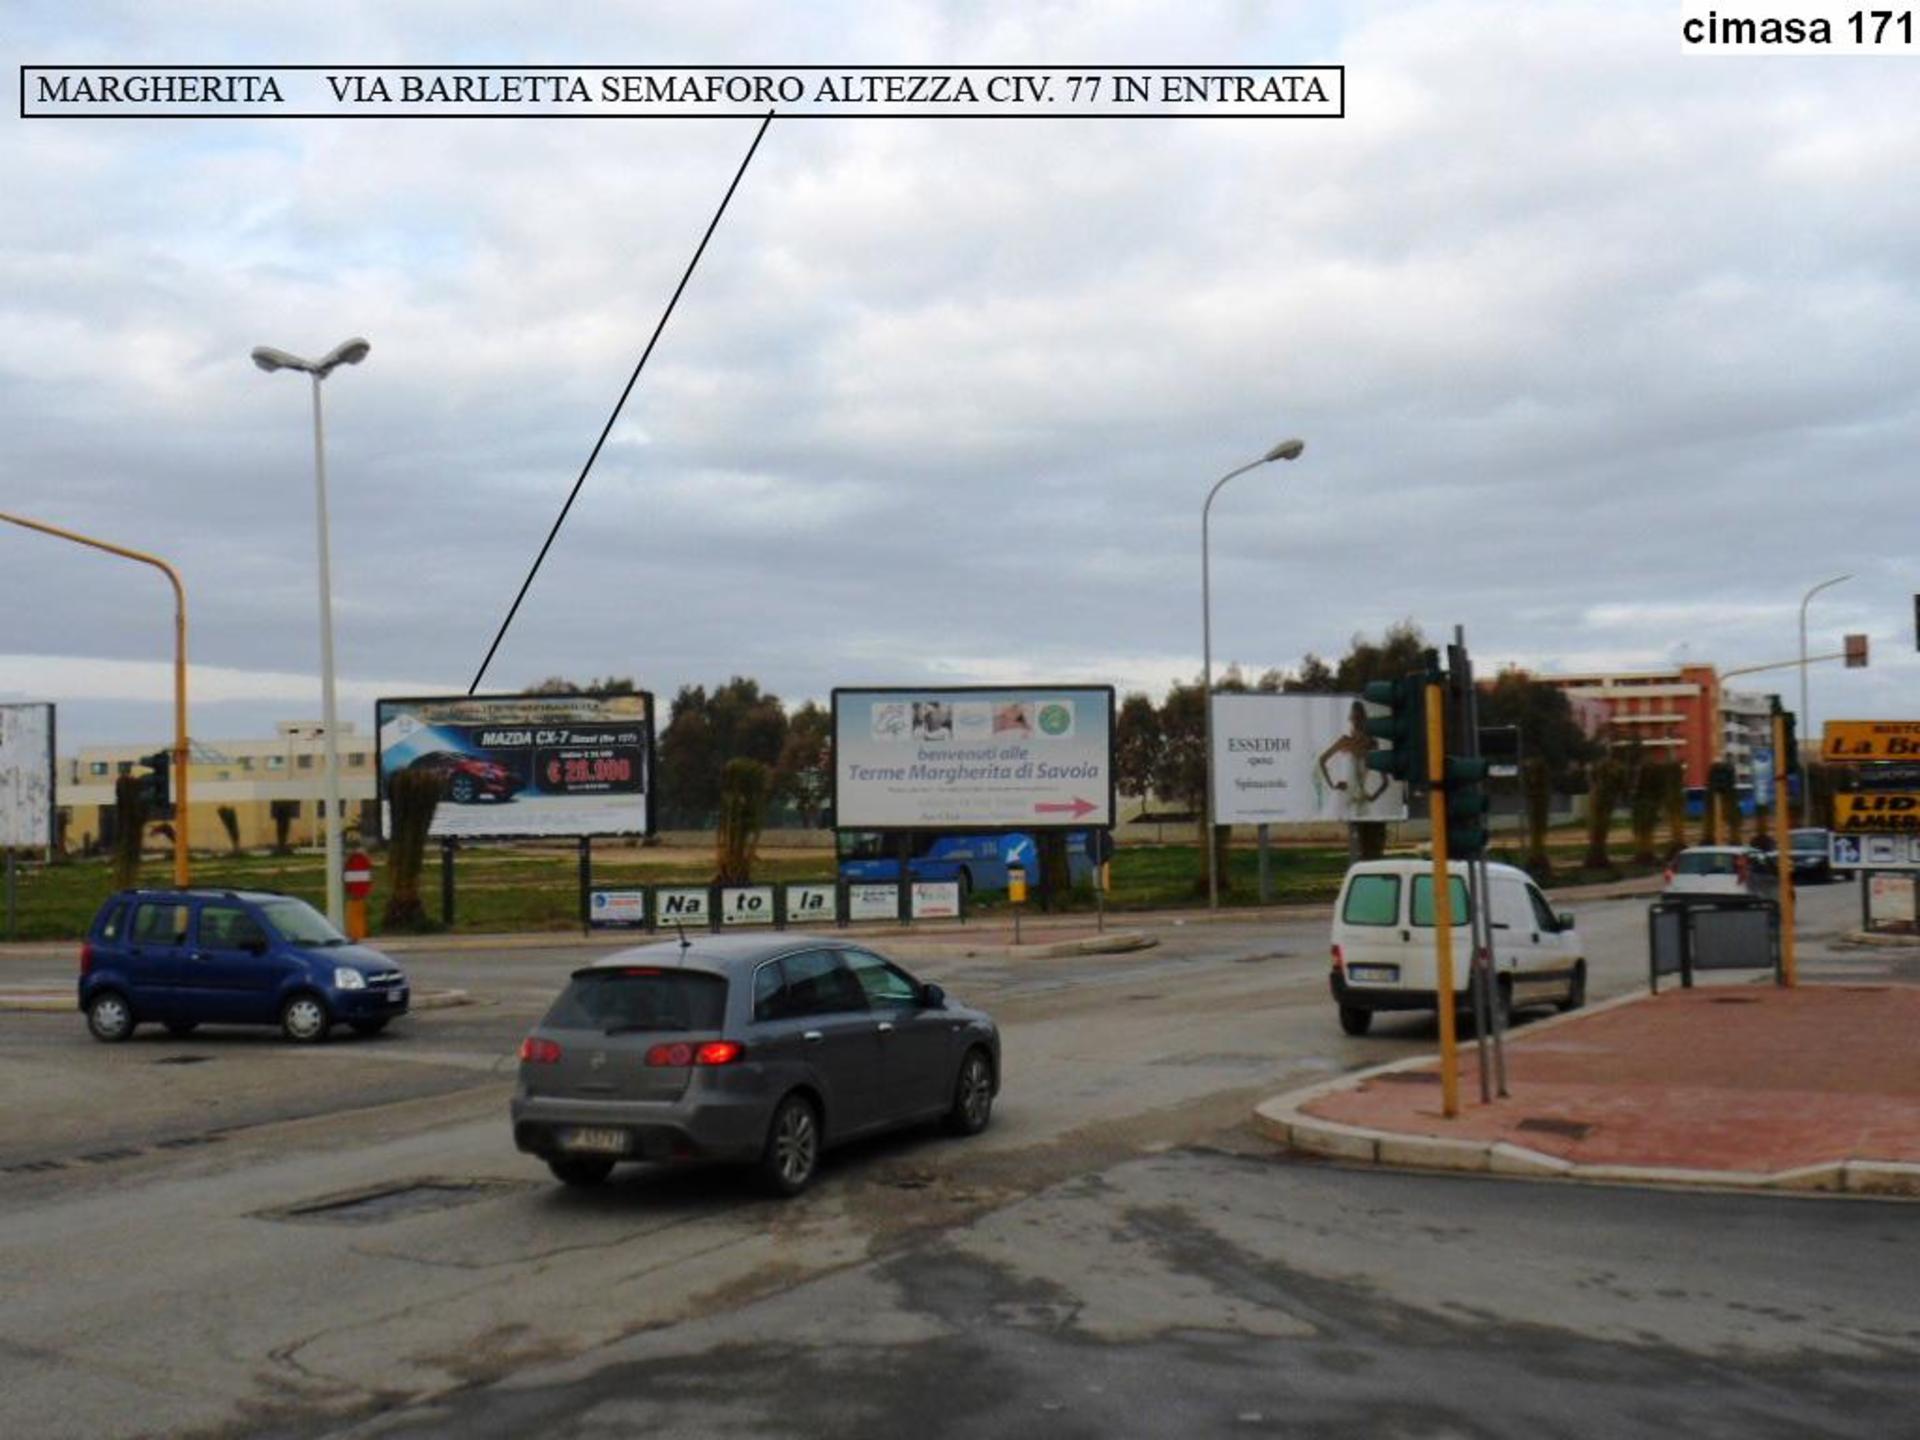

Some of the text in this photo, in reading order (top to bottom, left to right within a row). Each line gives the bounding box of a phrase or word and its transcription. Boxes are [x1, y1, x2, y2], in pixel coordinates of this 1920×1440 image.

[481, 731, 532, 746] MAZDA
[536, 730, 569, 745] CX-7
[1228, 738, 1291, 752] ESSEDDI
[1832, 736, 1873, 754] La
[917, 748, 1029, 761] benvenuti alle
[849, 761, 1099, 783] Terme Margherita di Savoia
[665, 895, 702, 914] Na
[736, 892, 763, 911] to
